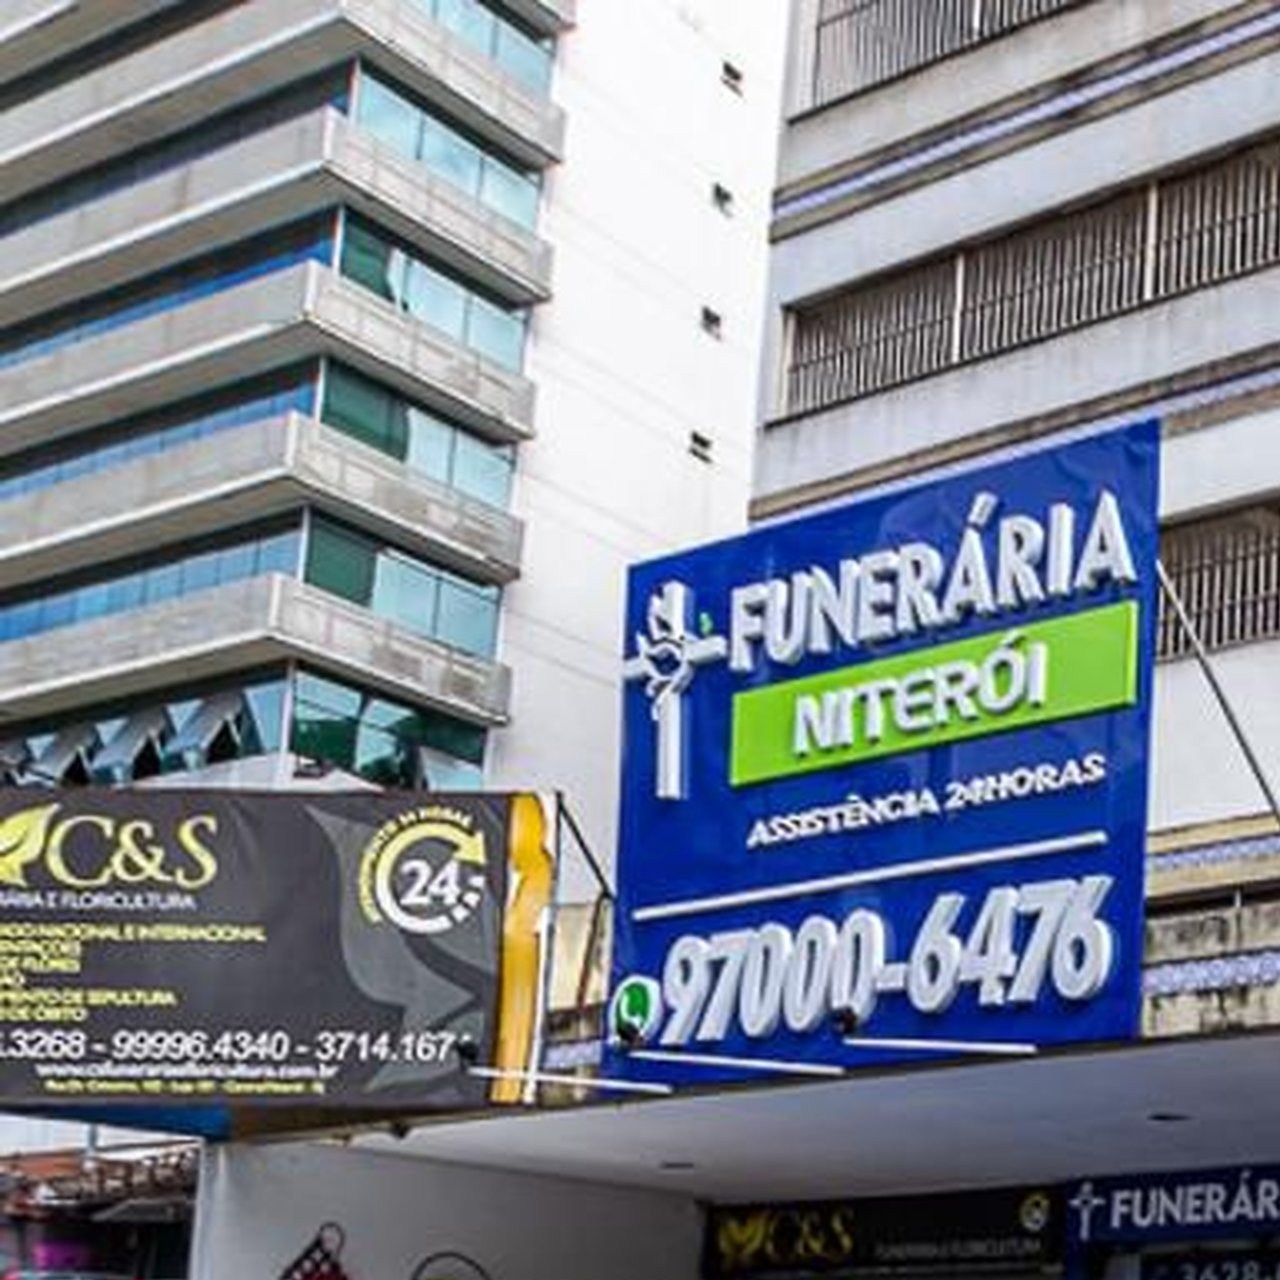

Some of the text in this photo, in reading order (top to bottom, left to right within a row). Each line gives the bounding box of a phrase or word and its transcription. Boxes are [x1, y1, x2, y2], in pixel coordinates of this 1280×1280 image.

[729, 491, 1138, 671] FUNERÁRIA
[793, 629, 1049, 756] NITERÓI
[46, 814, 217, 889] C&S
[747, 790, 942, 847] ASSISTÊNCIA
[61, 891, 197, 912] FLORICULTURA
[400, 859, 460, 906] 24
[660, 875, 1114, 1046] 97000-6476
[112, 1029, 290, 1061] 99996.4340
[315, 1030, 473, 1061] 3714.167
